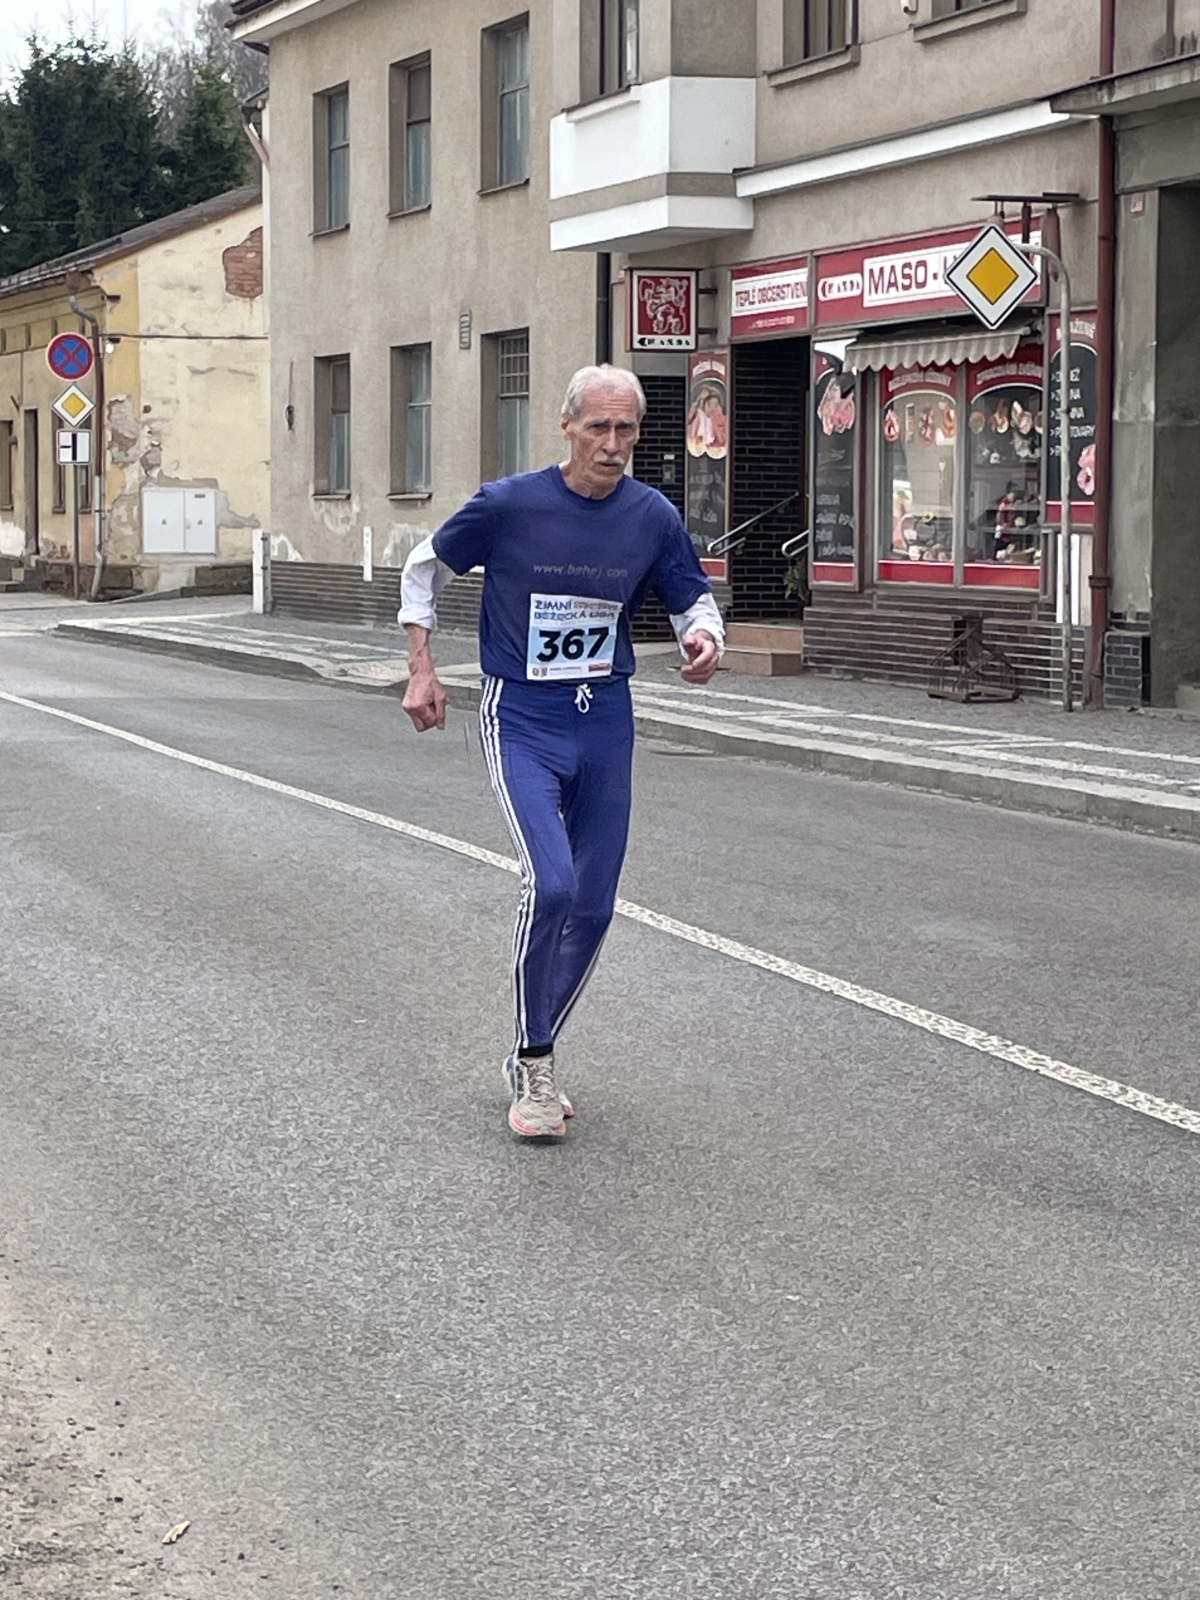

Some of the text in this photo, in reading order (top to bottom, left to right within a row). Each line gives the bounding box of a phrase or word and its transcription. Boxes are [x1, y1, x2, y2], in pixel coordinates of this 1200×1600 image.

[868, 259, 928, 297] MASO
[534, 599, 572, 611] ZIMNÍ
[536, 626, 610, 662] 367
